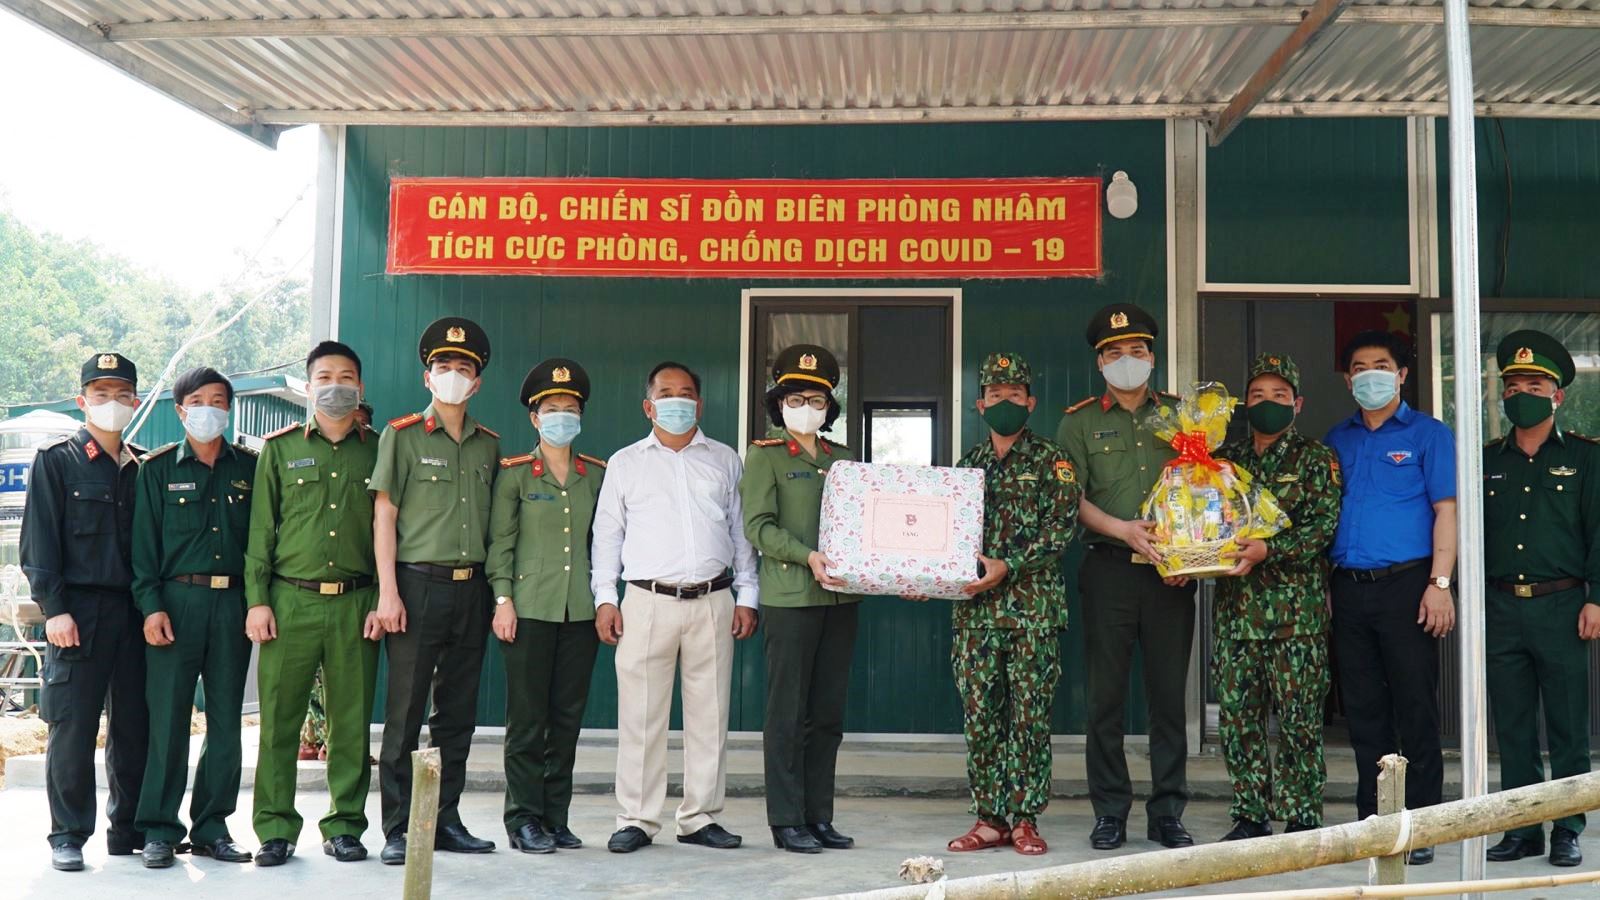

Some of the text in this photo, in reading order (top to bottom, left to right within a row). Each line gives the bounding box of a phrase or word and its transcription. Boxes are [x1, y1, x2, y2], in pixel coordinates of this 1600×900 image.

[429, 189, 1065, 225] CÁN BỘ, CHIẾN SĨ ĐỒN BIÊN PHÒNG NHÂM
[427, 231, 494, 259] TÍCH
[505, 234, 565, 264] CỰC
[577, 233, 687, 263] PHÒNG,
[700, 229, 802, 263] CHỐNG
[815, 238, 887, 267] DỊCH
[900, 237, 992, 263] COVID
[1032, 238, 1065, 261] 19
